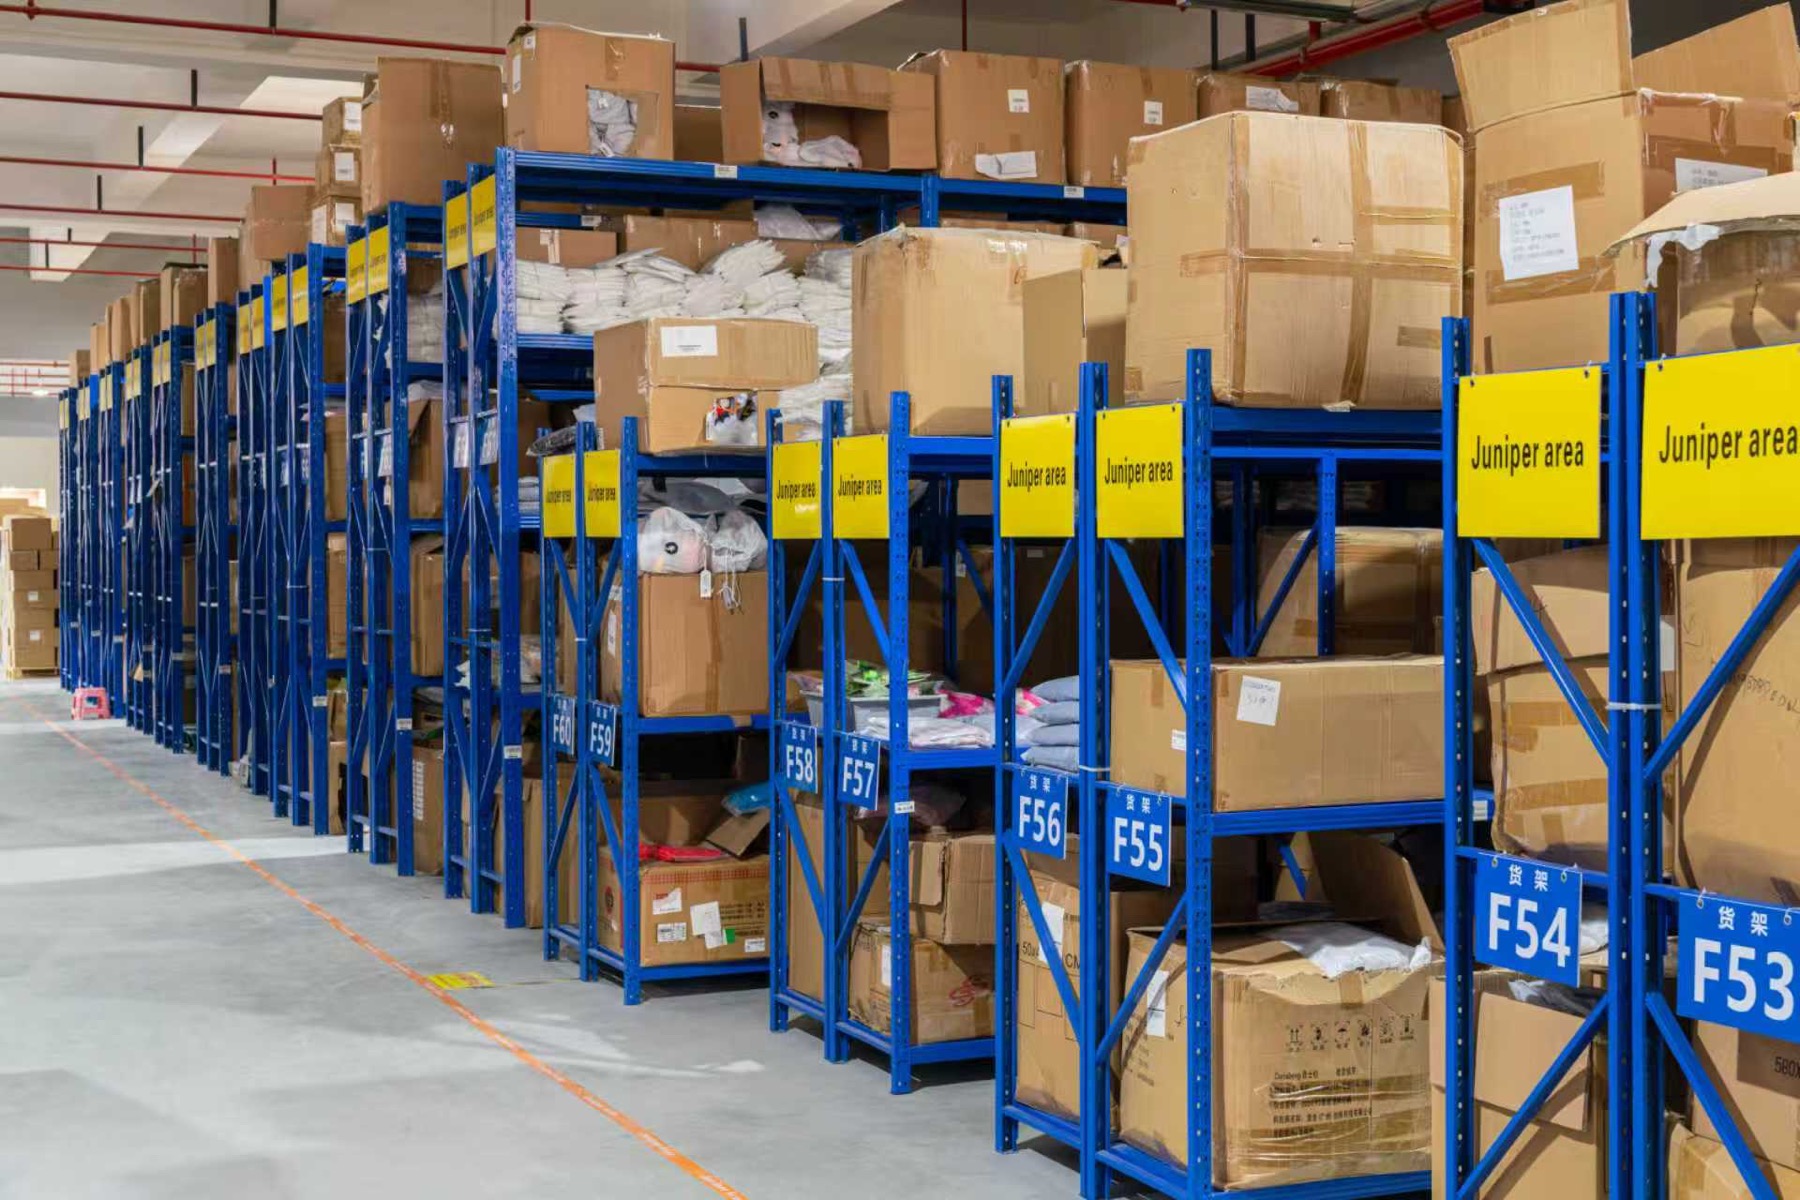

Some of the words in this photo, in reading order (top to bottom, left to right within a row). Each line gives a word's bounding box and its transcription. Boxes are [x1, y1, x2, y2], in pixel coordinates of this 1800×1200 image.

[1471, 434, 1539, 476] Juniper
[1544, 440, 1584, 467] area
[1659, 422, 1743, 469] Juniper
[1749, 425, 1799, 457] area
[776, 480, 801, 503] Juniper
[802, 482, 816, 498] area
[838, 473, 865, 501] Juniper
[866, 479, 882, 496] area
[1007, 462, 1043, 492] Juniper
[1045, 466, 1066, 486] area
[1104, 457, 1145, 489] Juniper
[1148, 460, 1173, 482] area
[553, 714, 571, 747] F60
[590, 721, 612, 757] F59
[786, 744, 813, 783] F58
[842, 756, 875, 798] F57
[1018, 795, 1061, 847] F56
[1113, 816, 1163, 872] F55
[1488, 891, 1571, 968] F54
[1693, 936, 1794, 1021] F53
